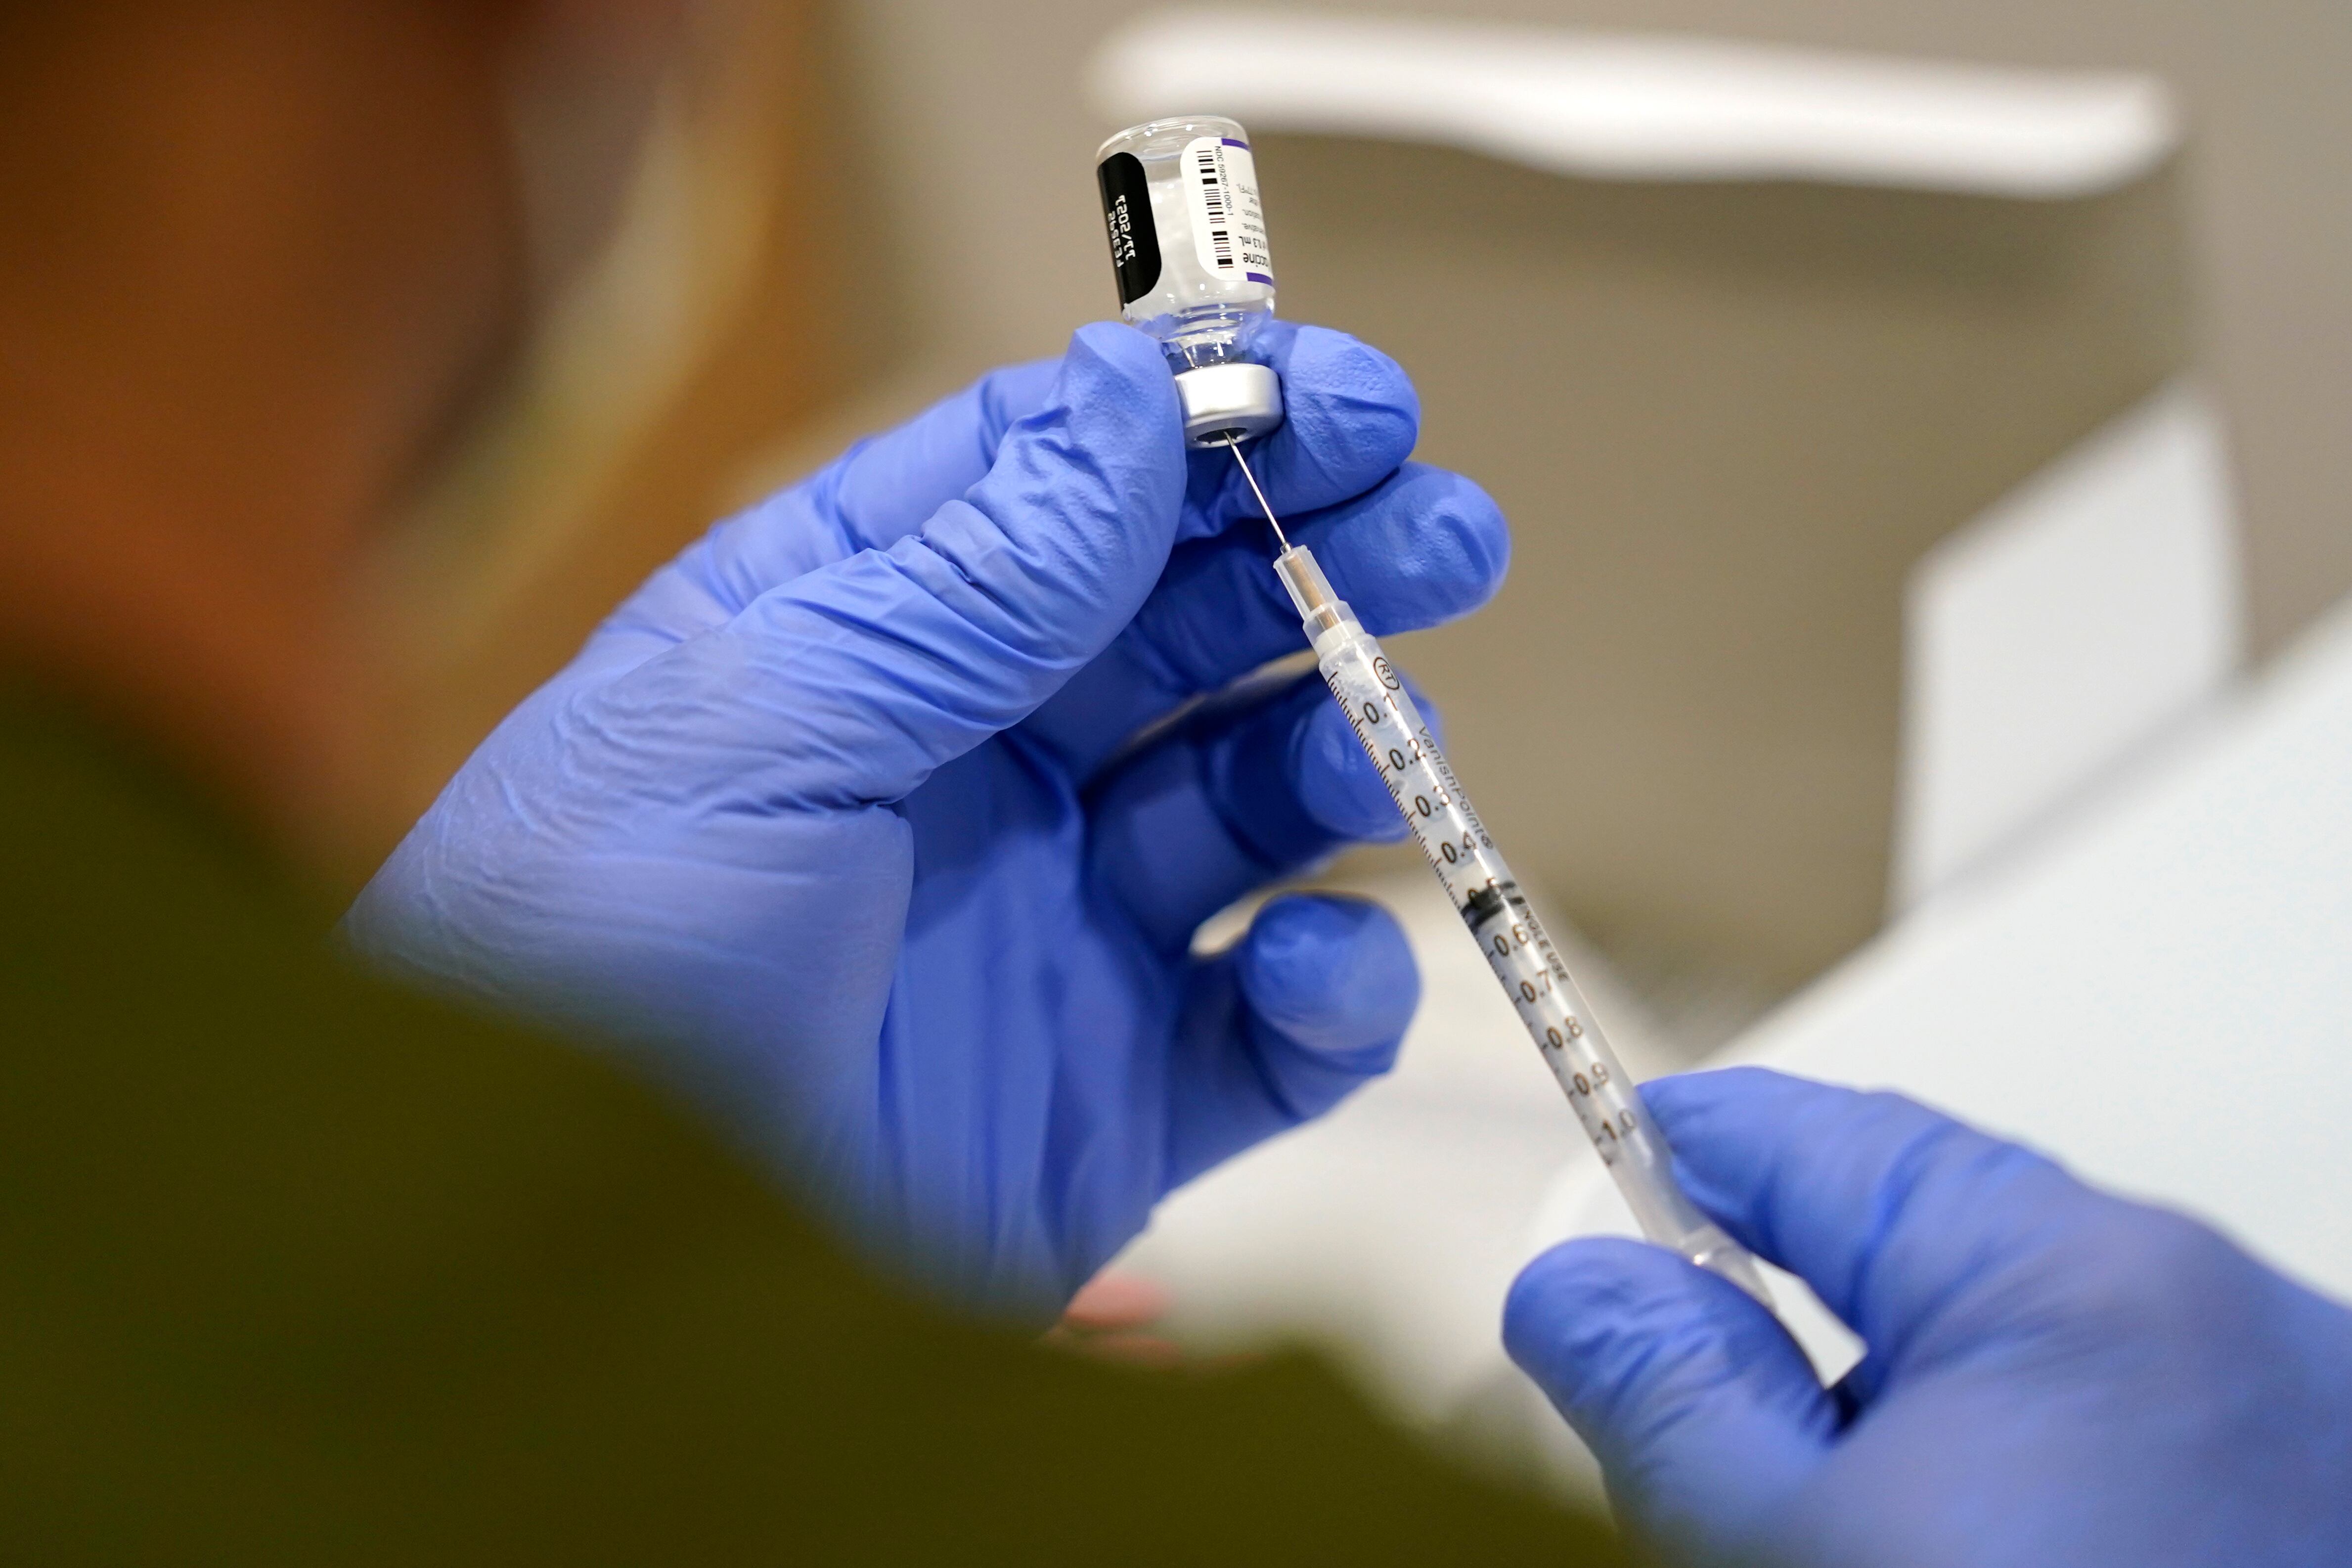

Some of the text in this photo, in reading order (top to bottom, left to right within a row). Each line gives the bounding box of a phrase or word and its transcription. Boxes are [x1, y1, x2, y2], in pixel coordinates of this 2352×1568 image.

[1215, 146, 1224, 162] NDC
[1115, 194, 1136, 261] 11/2021
[1377, 663, 1397, 683] RT
[1363, 692, 1398, 724] 0.1
[1388, 738, 1426, 770] 0.2
[1415, 785, 1450, 817] 0.3
[1441, 831, 1477, 863] 0.4
[1494, 924, 1529, 957] 0.6
[1519, 969, 1553, 1003] 0.7
[1546, 1016, 1583, 1049] 0.8
[1573, 1062, 1609, 1096] 0.9
[1601, 1108, 1637, 1140] 1.0
